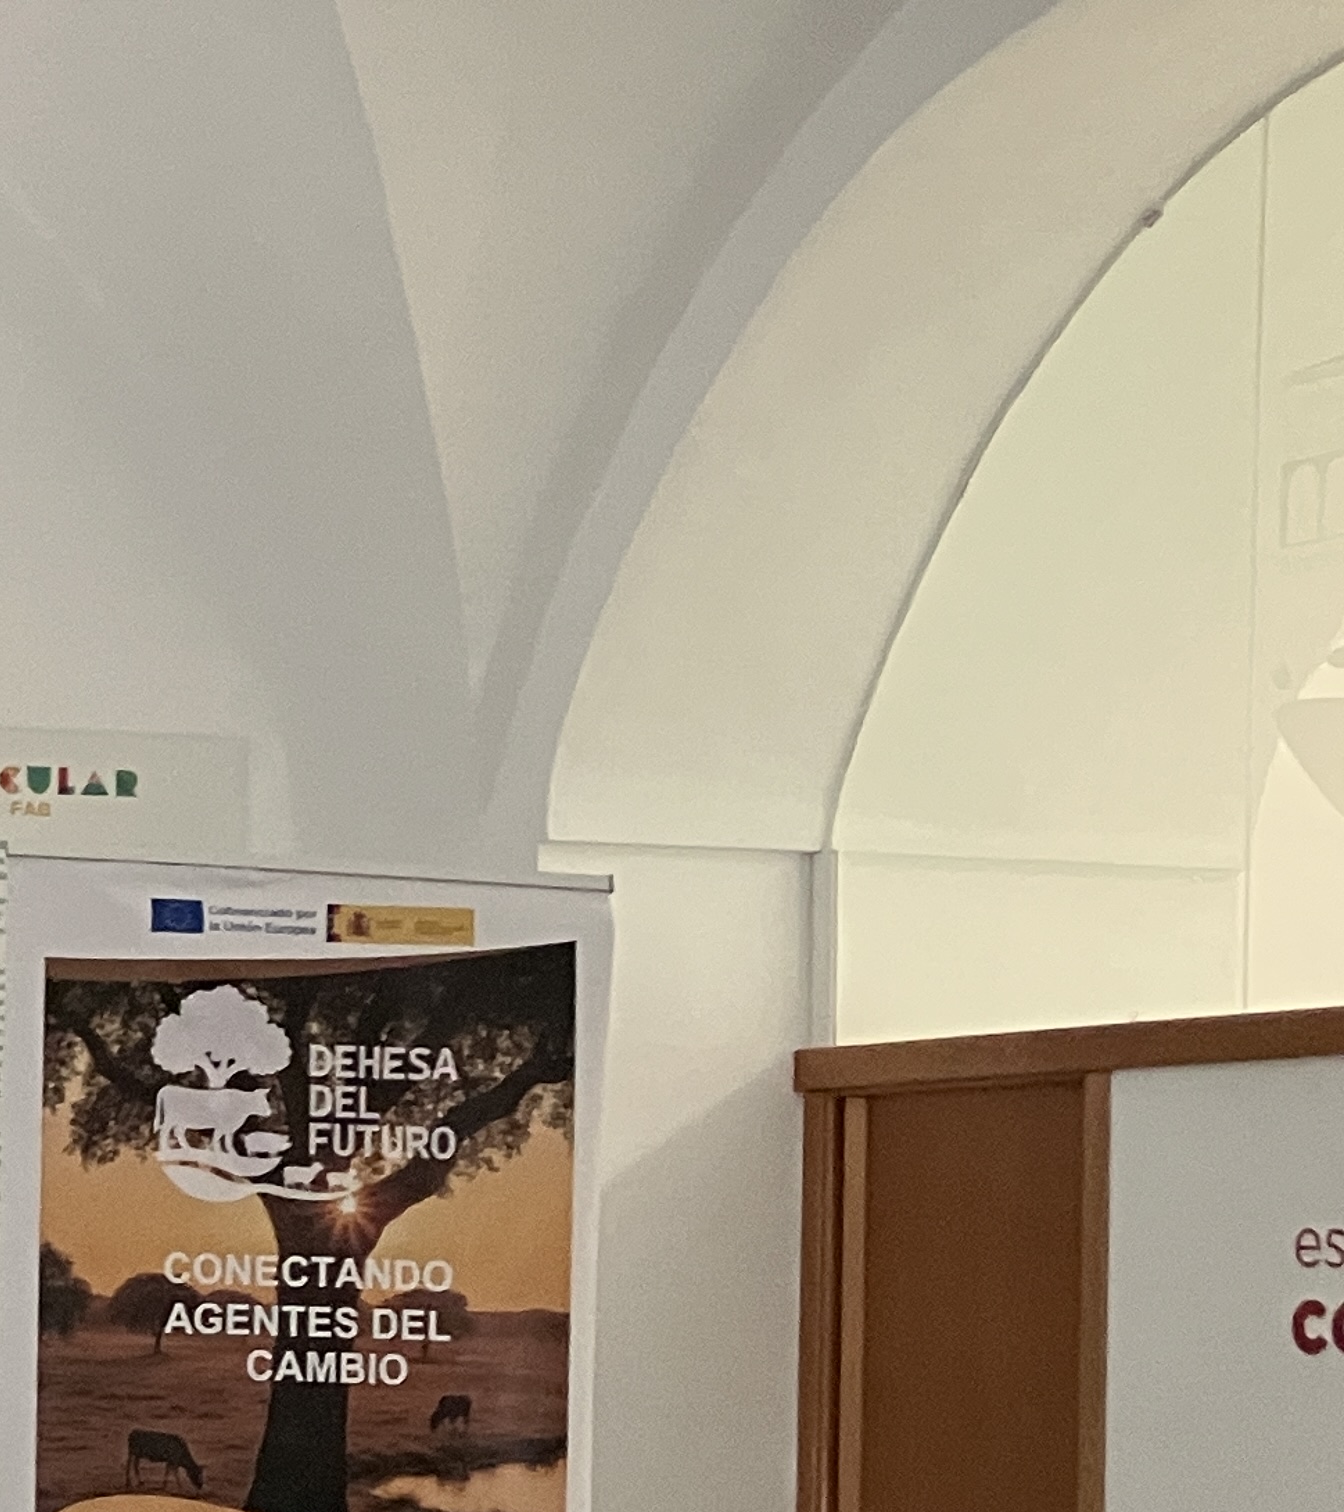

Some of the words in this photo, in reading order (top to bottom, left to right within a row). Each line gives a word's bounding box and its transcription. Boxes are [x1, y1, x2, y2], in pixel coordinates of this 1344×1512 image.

[10, 801, 52, 817] FAB
[309, 1043, 459, 1082] DEHESA
[309, 1084, 381, 1121] DEL
[309, 1123, 458, 1161] FUTURO
[163, 1251, 454, 1294] CONECTANDO
[164, 1302, 358, 1340] AGENTES
[372, 1308, 452, 1343] DEL
[245, 1349, 409, 1386] CAMBIO
